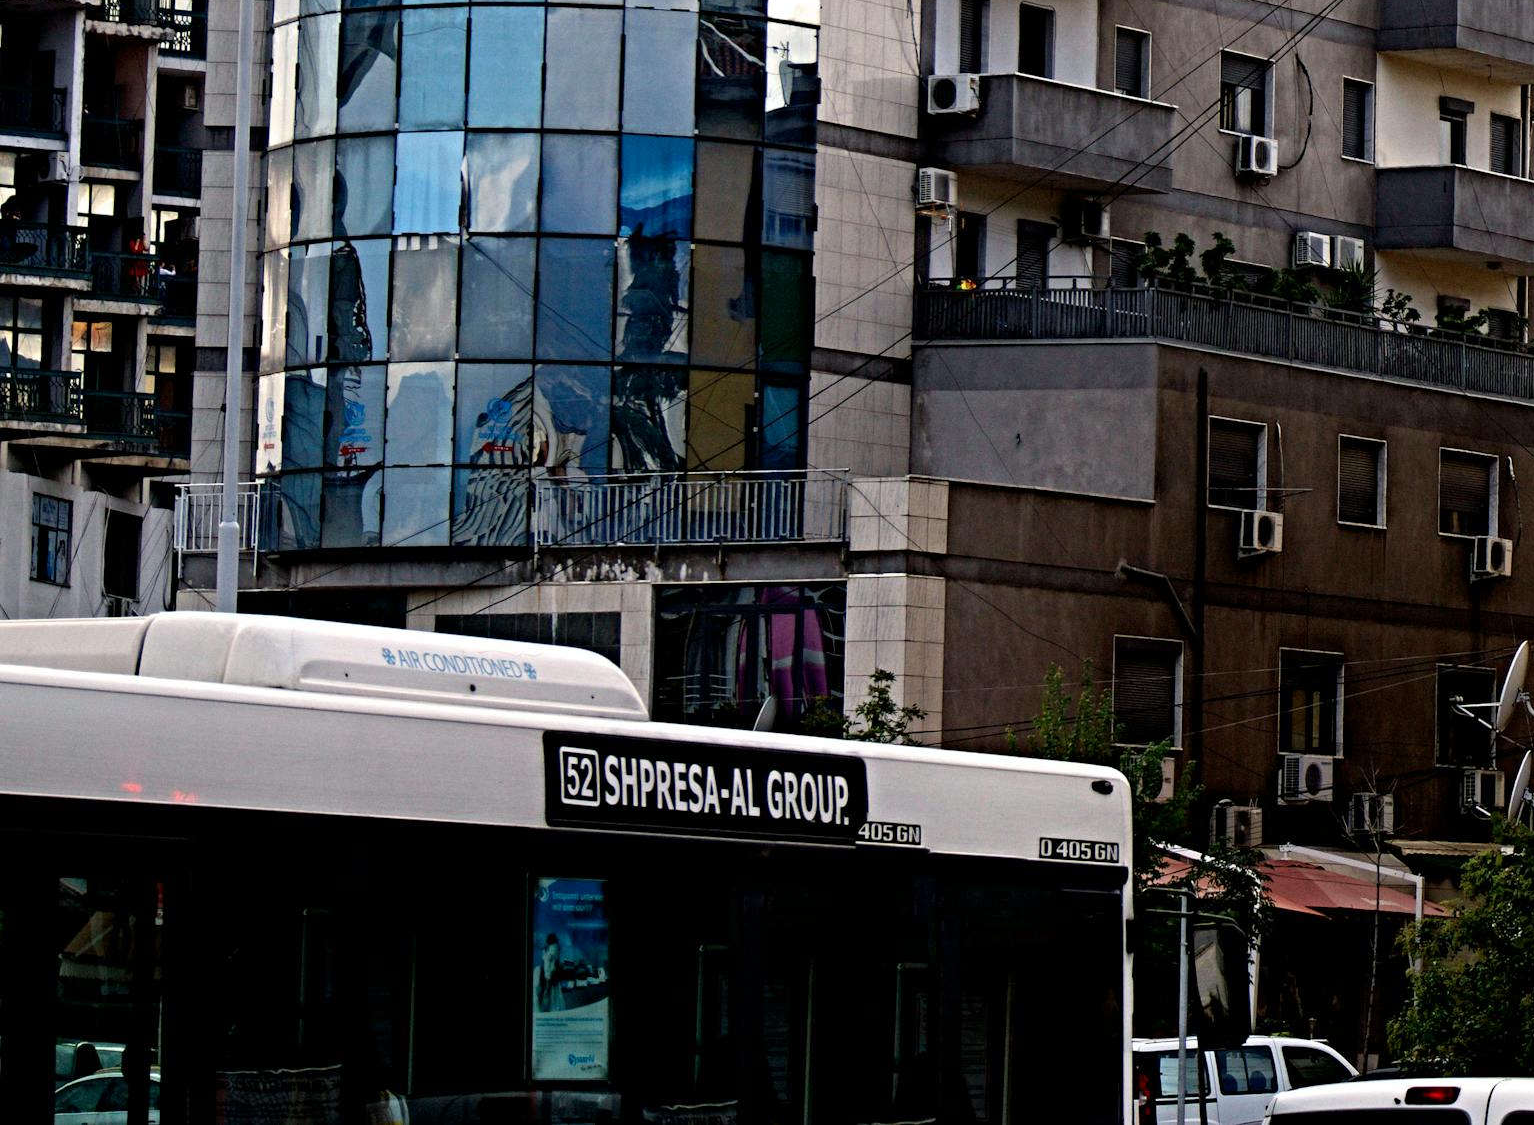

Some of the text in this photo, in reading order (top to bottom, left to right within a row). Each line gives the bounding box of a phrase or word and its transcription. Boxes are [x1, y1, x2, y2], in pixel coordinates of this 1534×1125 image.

[398, 649, 523, 679] AIR CONDITIONED
[566, 755, 595, 798] 52
[604, 754, 761, 817] SHPRESA-AL
[857, 822, 921, 844] 405 GN
[1055, 839, 1092, 860] 405
[1094, 842, 1119, 862] GN
